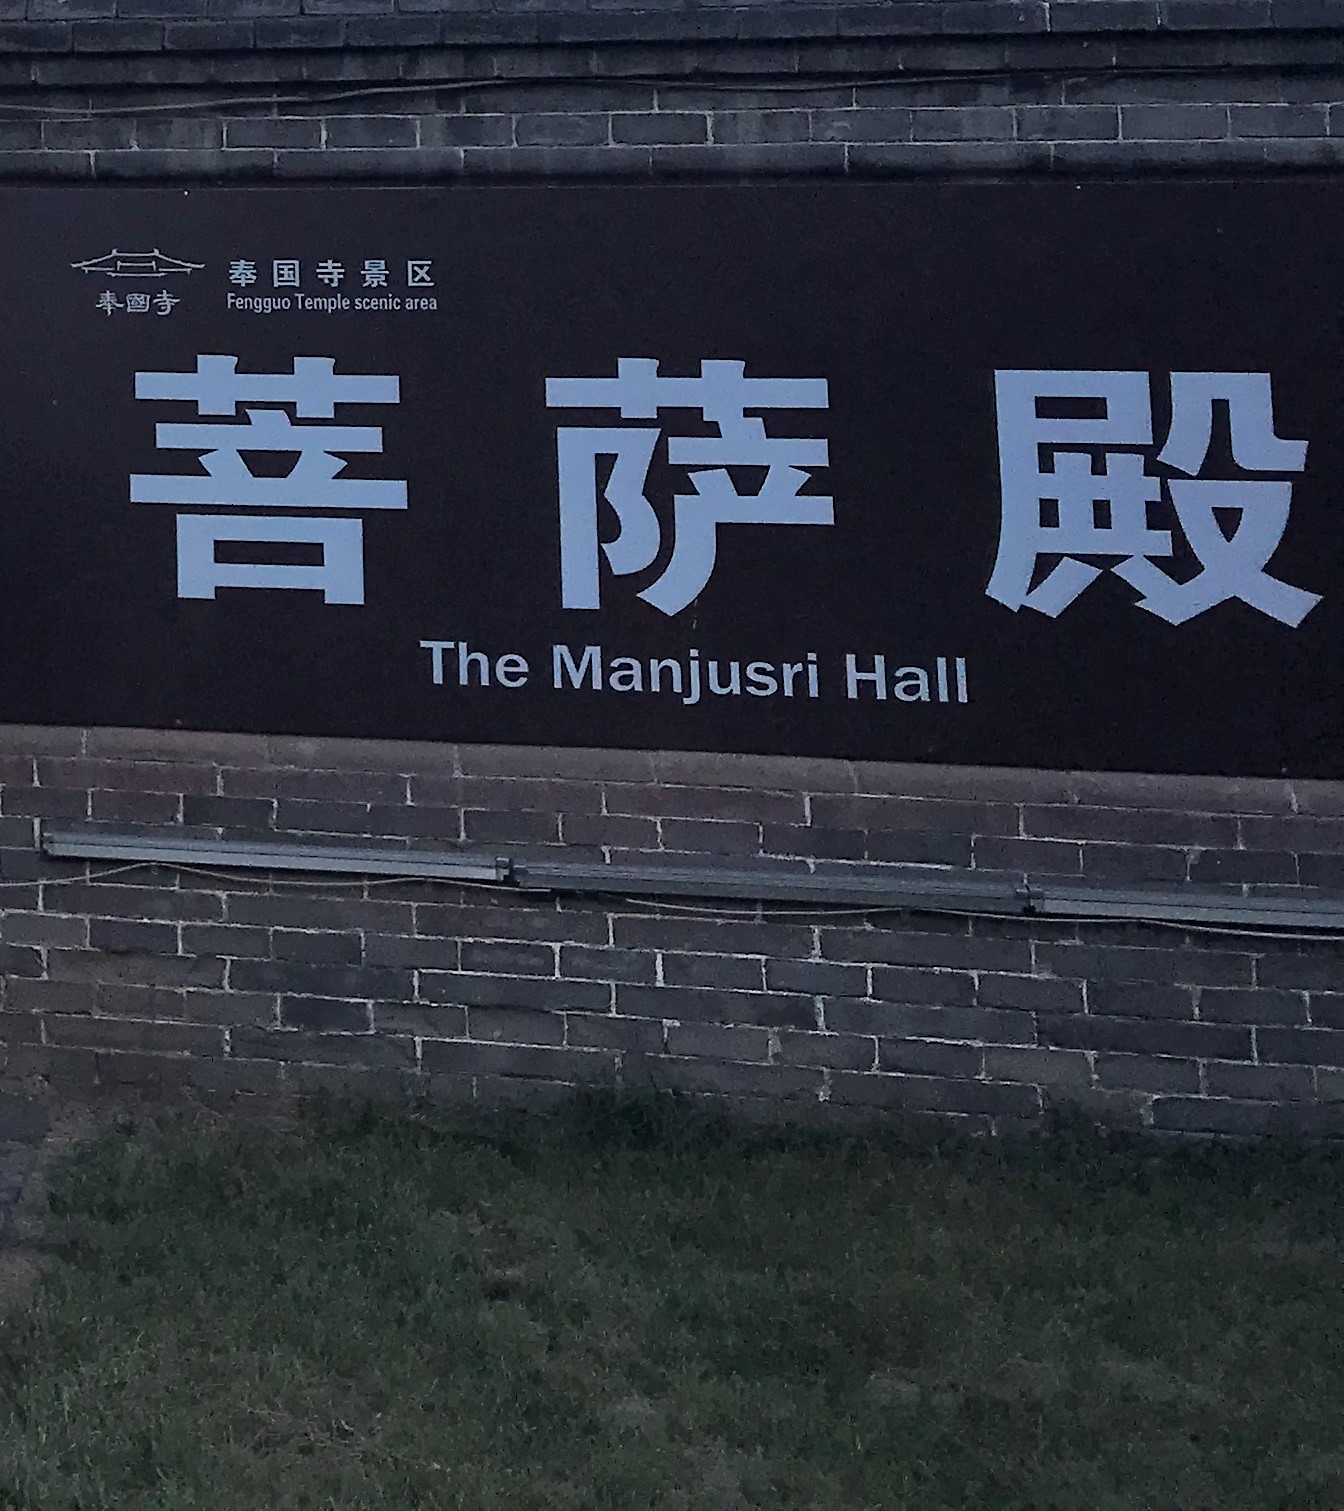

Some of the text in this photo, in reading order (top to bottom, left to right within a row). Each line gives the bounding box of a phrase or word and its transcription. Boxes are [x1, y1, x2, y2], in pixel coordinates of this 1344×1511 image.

[227, 258, 436, 289] 奉国寺景区
[226, 292, 438, 315] Fengguo Temple scenic area
[128, 353, 1324, 629] 菩萨殿
[418, 639, 969, 706] The Manjusri Hall
